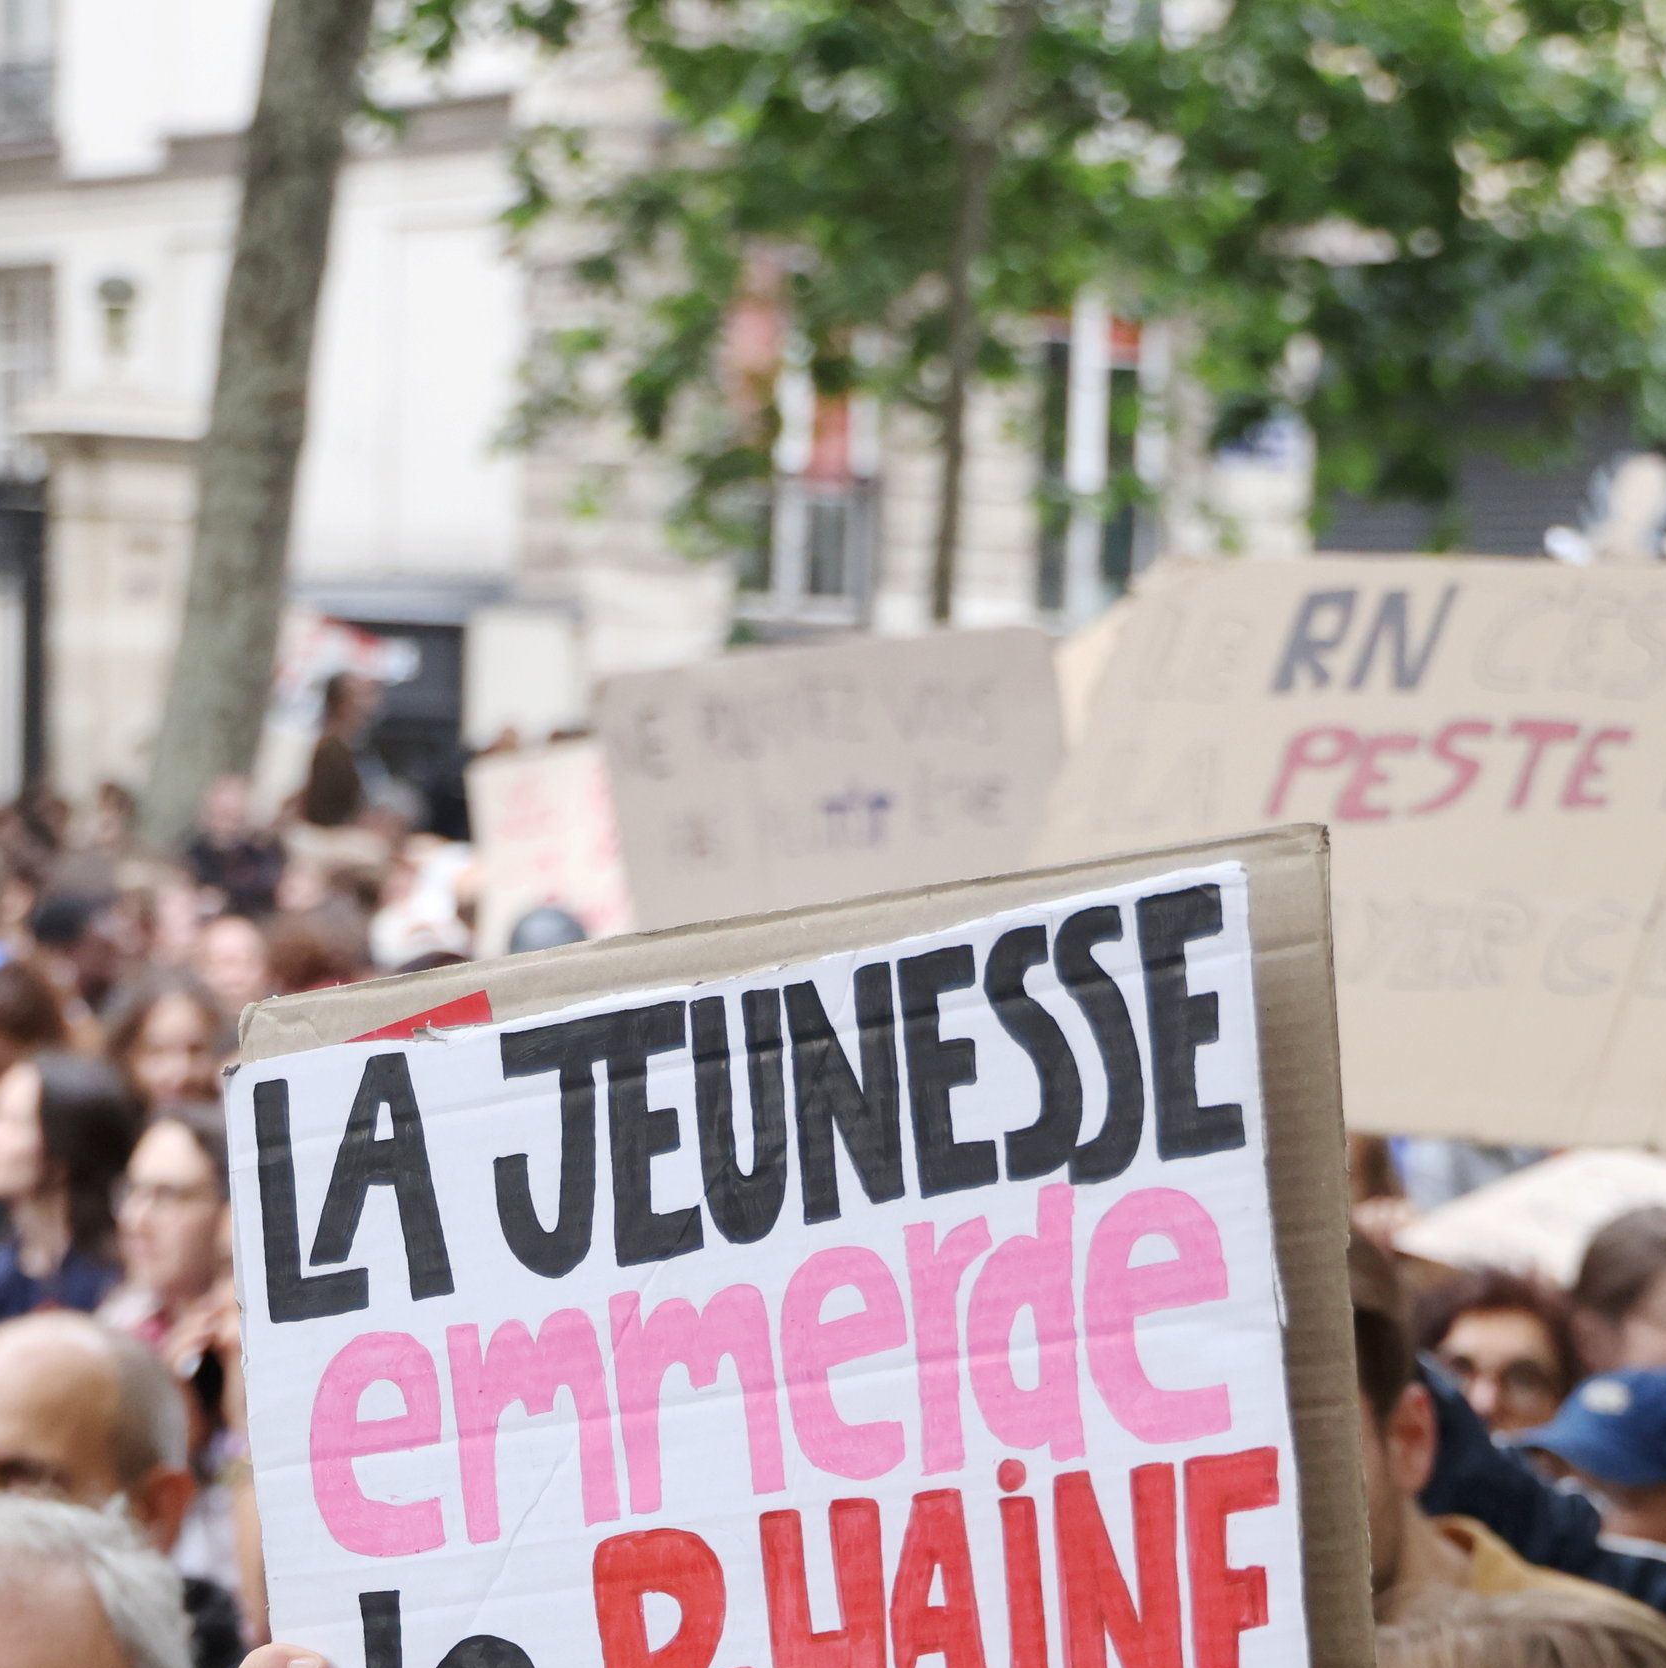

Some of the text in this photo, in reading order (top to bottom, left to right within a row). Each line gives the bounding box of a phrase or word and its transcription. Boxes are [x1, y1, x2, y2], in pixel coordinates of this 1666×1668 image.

[1271, 582, 1461, 695] RN
[1263, 716, 1635, 823] PESTE
[252, 883, 1247, 1325] LA JEUNESSE
[308, 1181, 1233, 1558] emmerde
